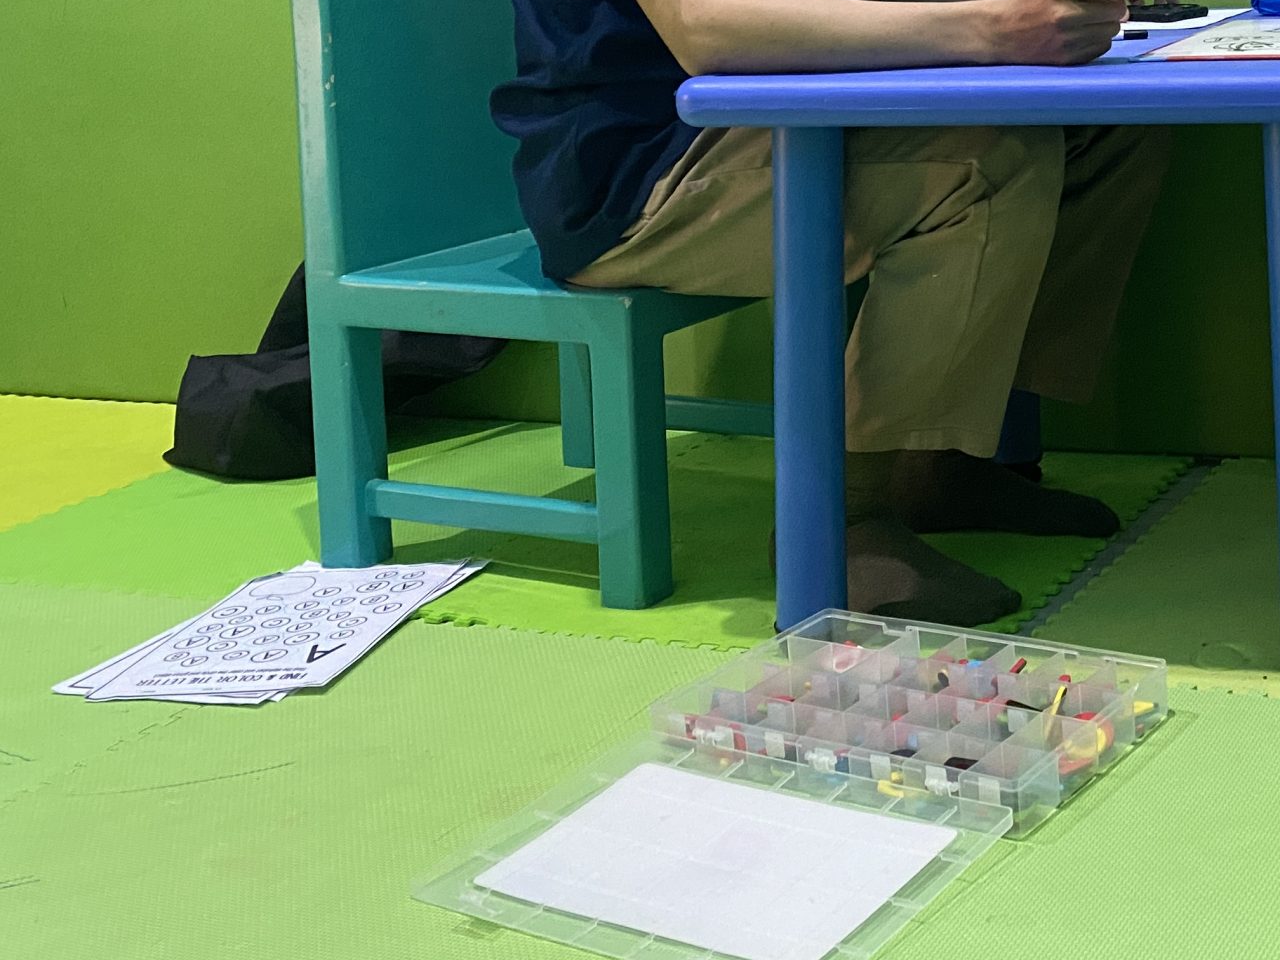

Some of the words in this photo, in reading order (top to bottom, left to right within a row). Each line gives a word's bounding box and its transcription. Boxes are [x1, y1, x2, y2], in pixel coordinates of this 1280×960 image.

[306, 643, 347, 663] A
[136, 677, 187, 687] LETTER
[188, 676, 212, 685] THE
[216, 674, 263, 684] COLOR
[278, 673, 308, 681] FIND
